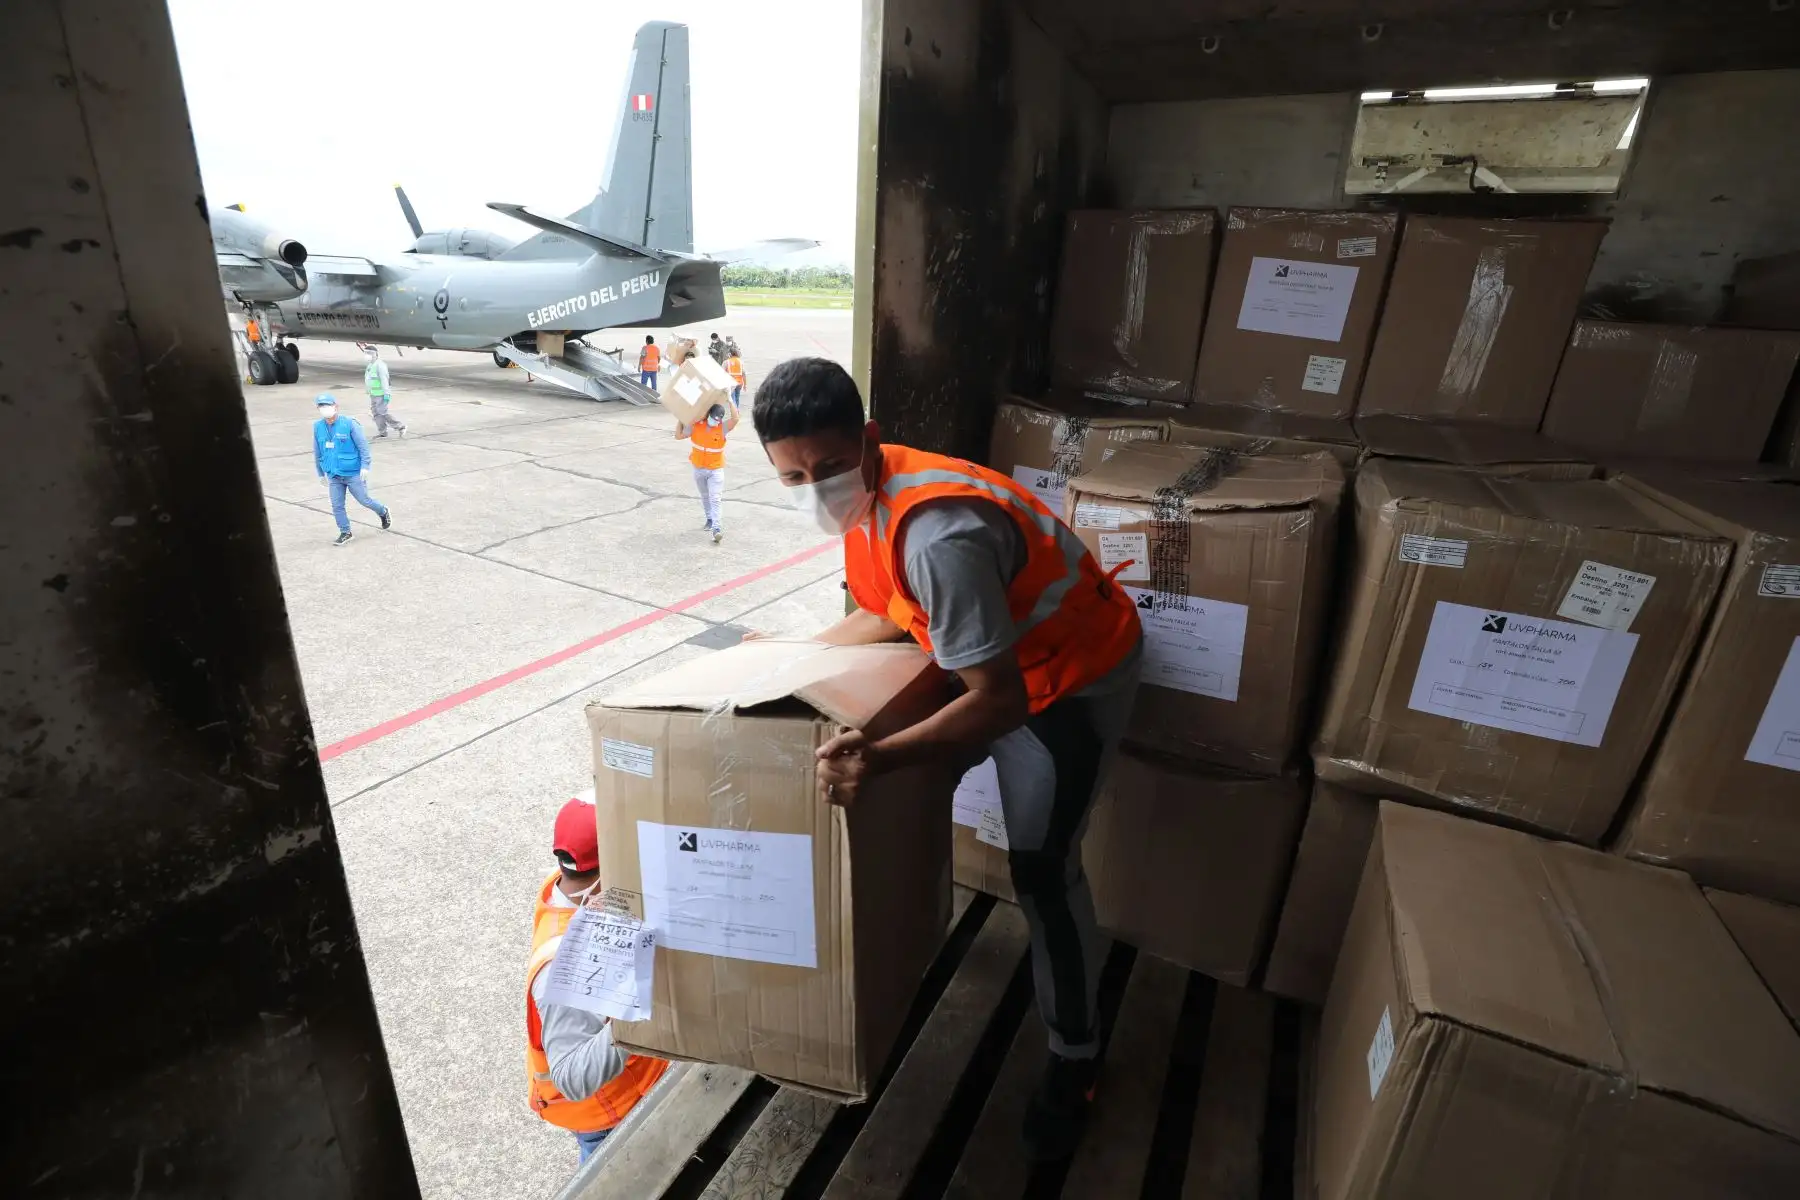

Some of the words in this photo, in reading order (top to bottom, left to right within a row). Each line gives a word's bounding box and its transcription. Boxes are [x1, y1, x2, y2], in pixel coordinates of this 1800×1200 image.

[527, 295, 587, 329] EJERCITO
[590, 286, 618, 307] DEL
[621, 270, 660, 298] PERU
[1508, 623, 1577, 642] UVPHARMA
[701, 839, 761, 853] UVPHARMA
